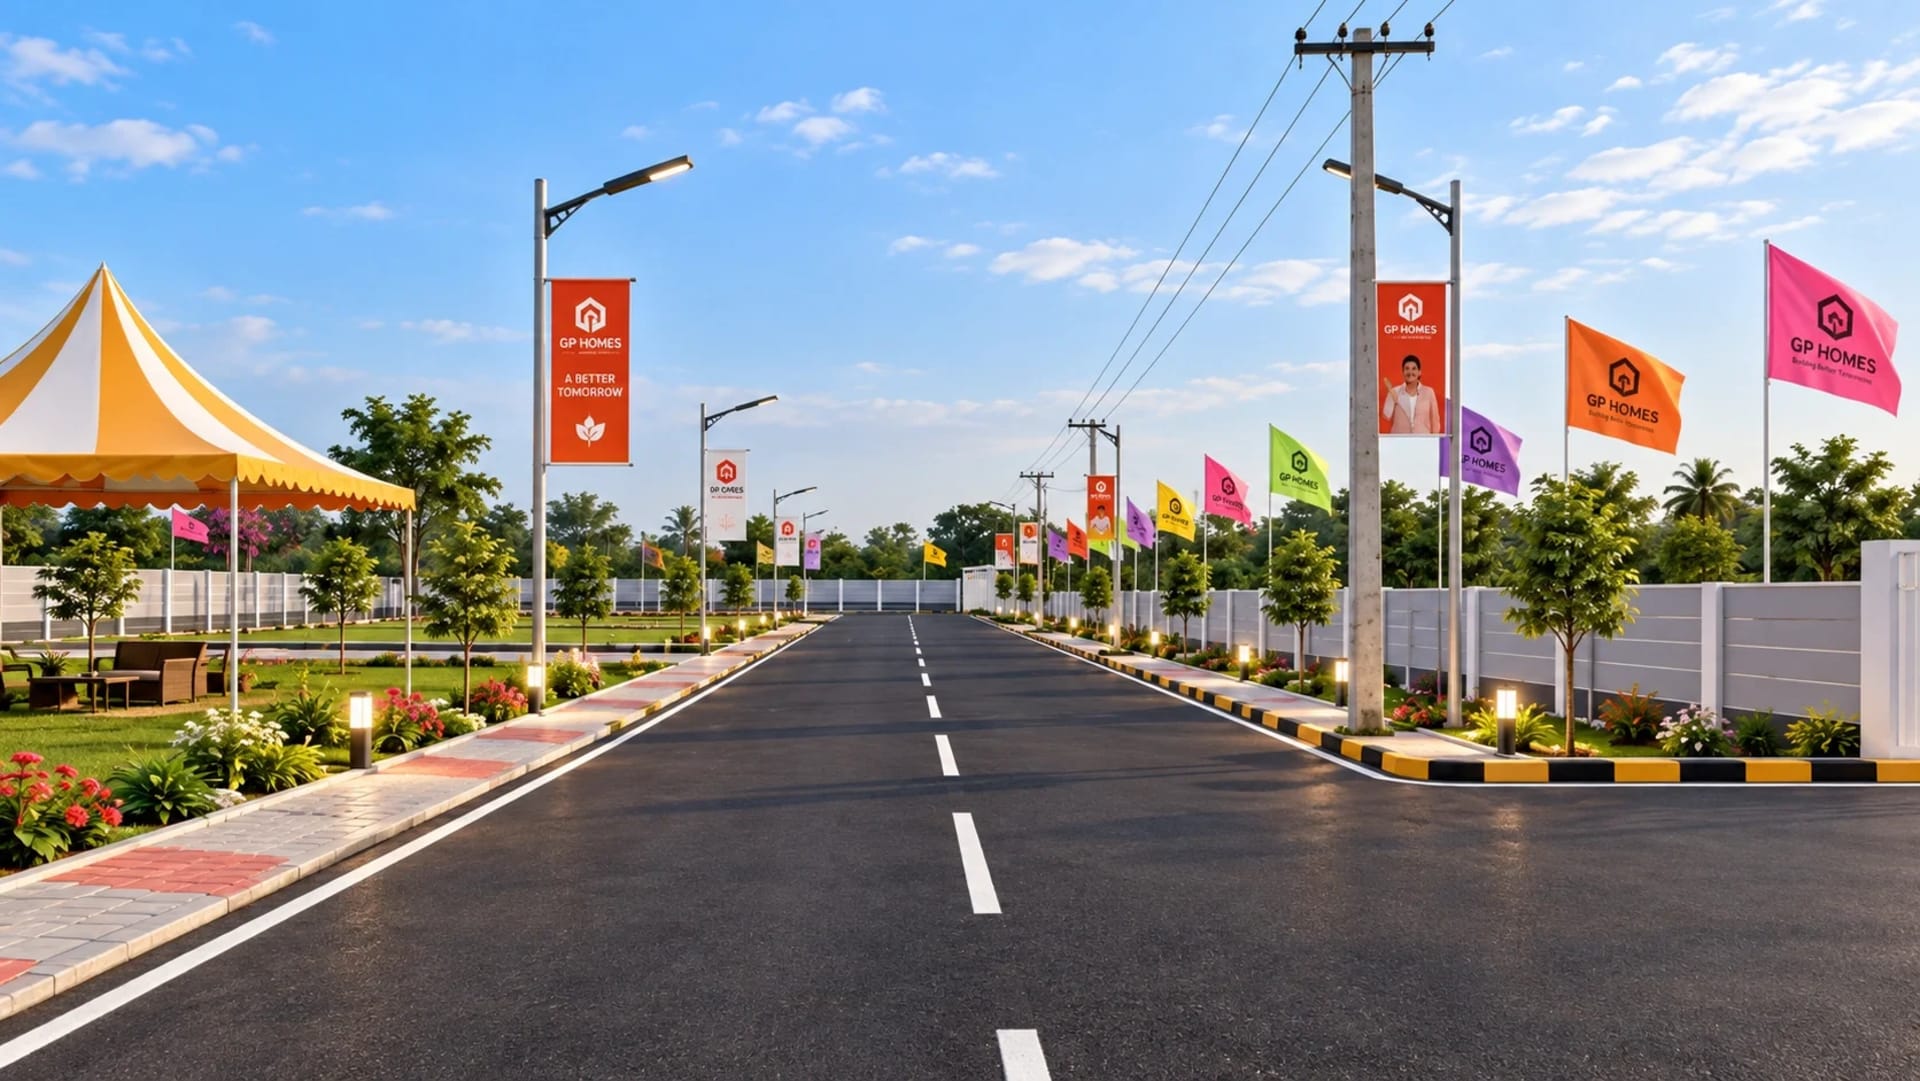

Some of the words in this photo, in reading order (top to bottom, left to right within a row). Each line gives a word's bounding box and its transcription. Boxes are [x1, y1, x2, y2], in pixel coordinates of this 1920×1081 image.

[1384, 324, 1399, 335] GP
[1400, 324, 1438, 335] HOMES
[559, 337, 577, 349] GP
[579, 337, 622, 349] HOMES
[1791, 337, 1814, 354] GP
[1817, 343, 1877, 375] HOMES
[564, 373, 573, 384] A
[575, 373, 616, 385] BETTER
[557, 386, 624, 398] TOMORROW
[1586, 393, 1606, 408] GP
[1609, 399, 1659, 424] HOMES
[1472, 456, 1507, 474] HOMES
[1292, 475, 1320, 490] HOMES
